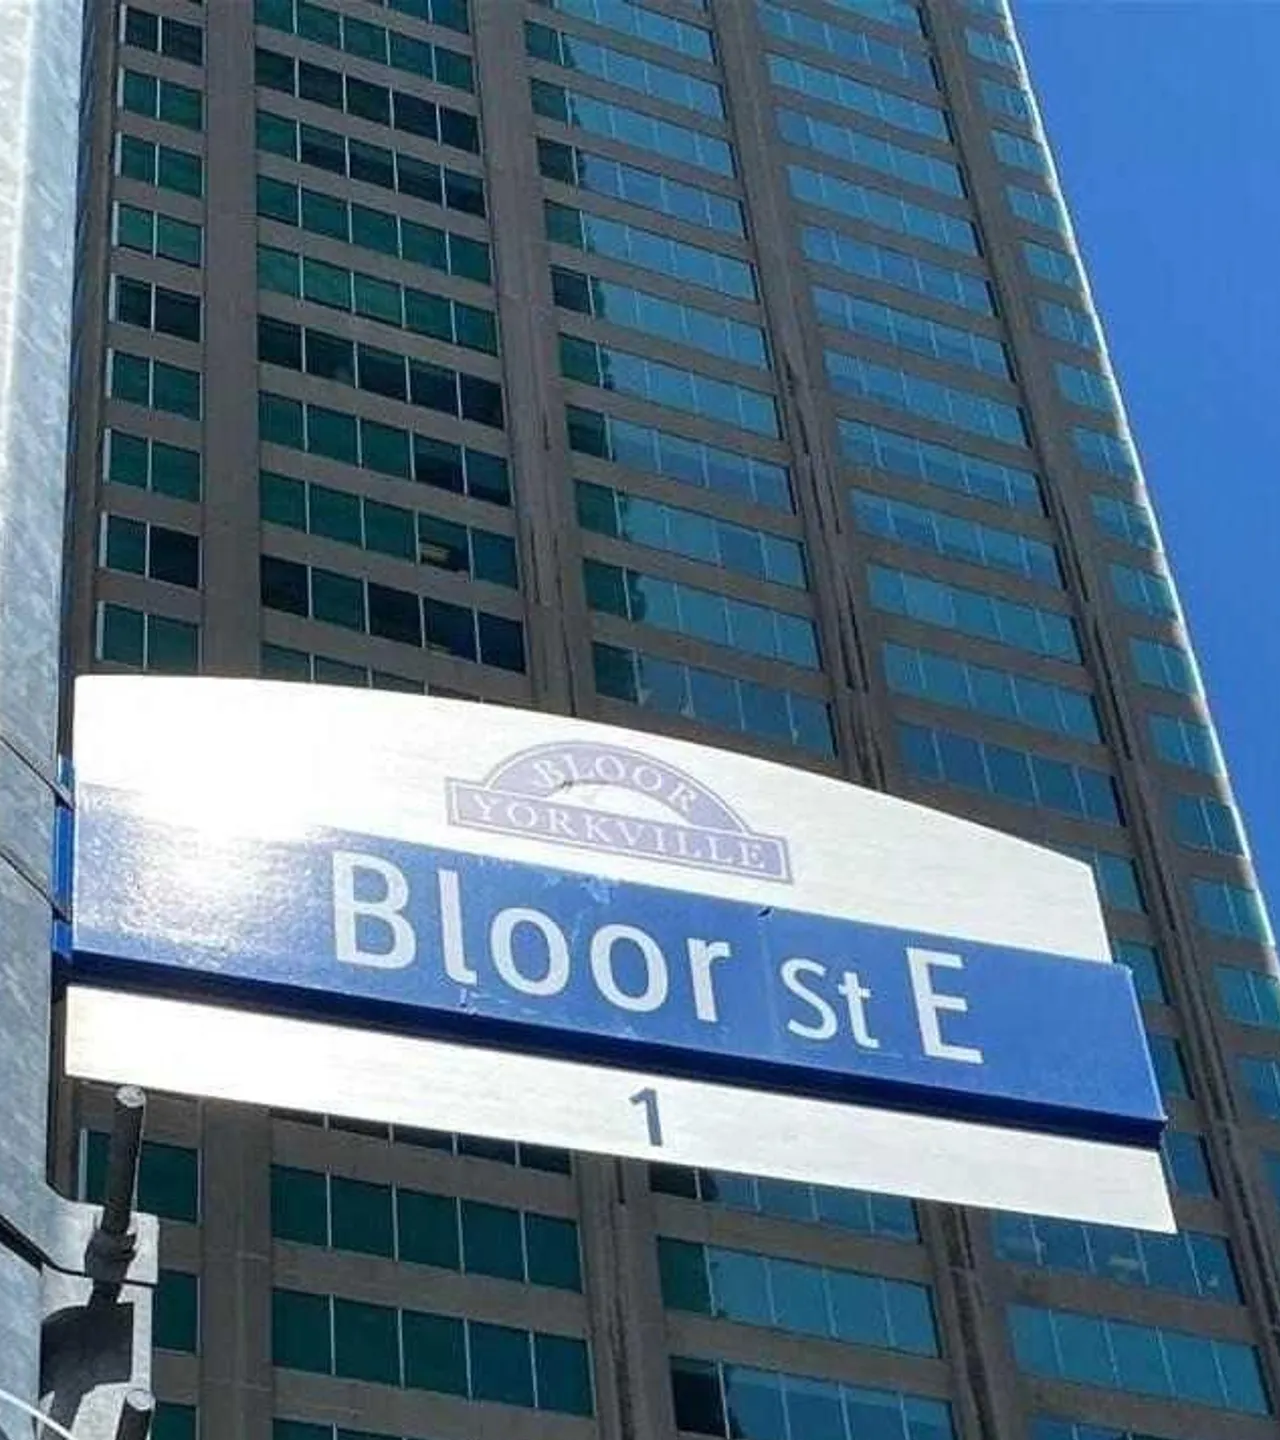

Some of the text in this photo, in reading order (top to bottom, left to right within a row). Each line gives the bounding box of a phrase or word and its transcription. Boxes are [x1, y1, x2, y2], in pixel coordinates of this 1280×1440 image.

[533, 753, 699, 817] BLOOR
[473, 793, 765, 869] YORKVILLE
[331, 851, 984, 1065] Bloor St E
[628, 1087, 663, 1147] 1
